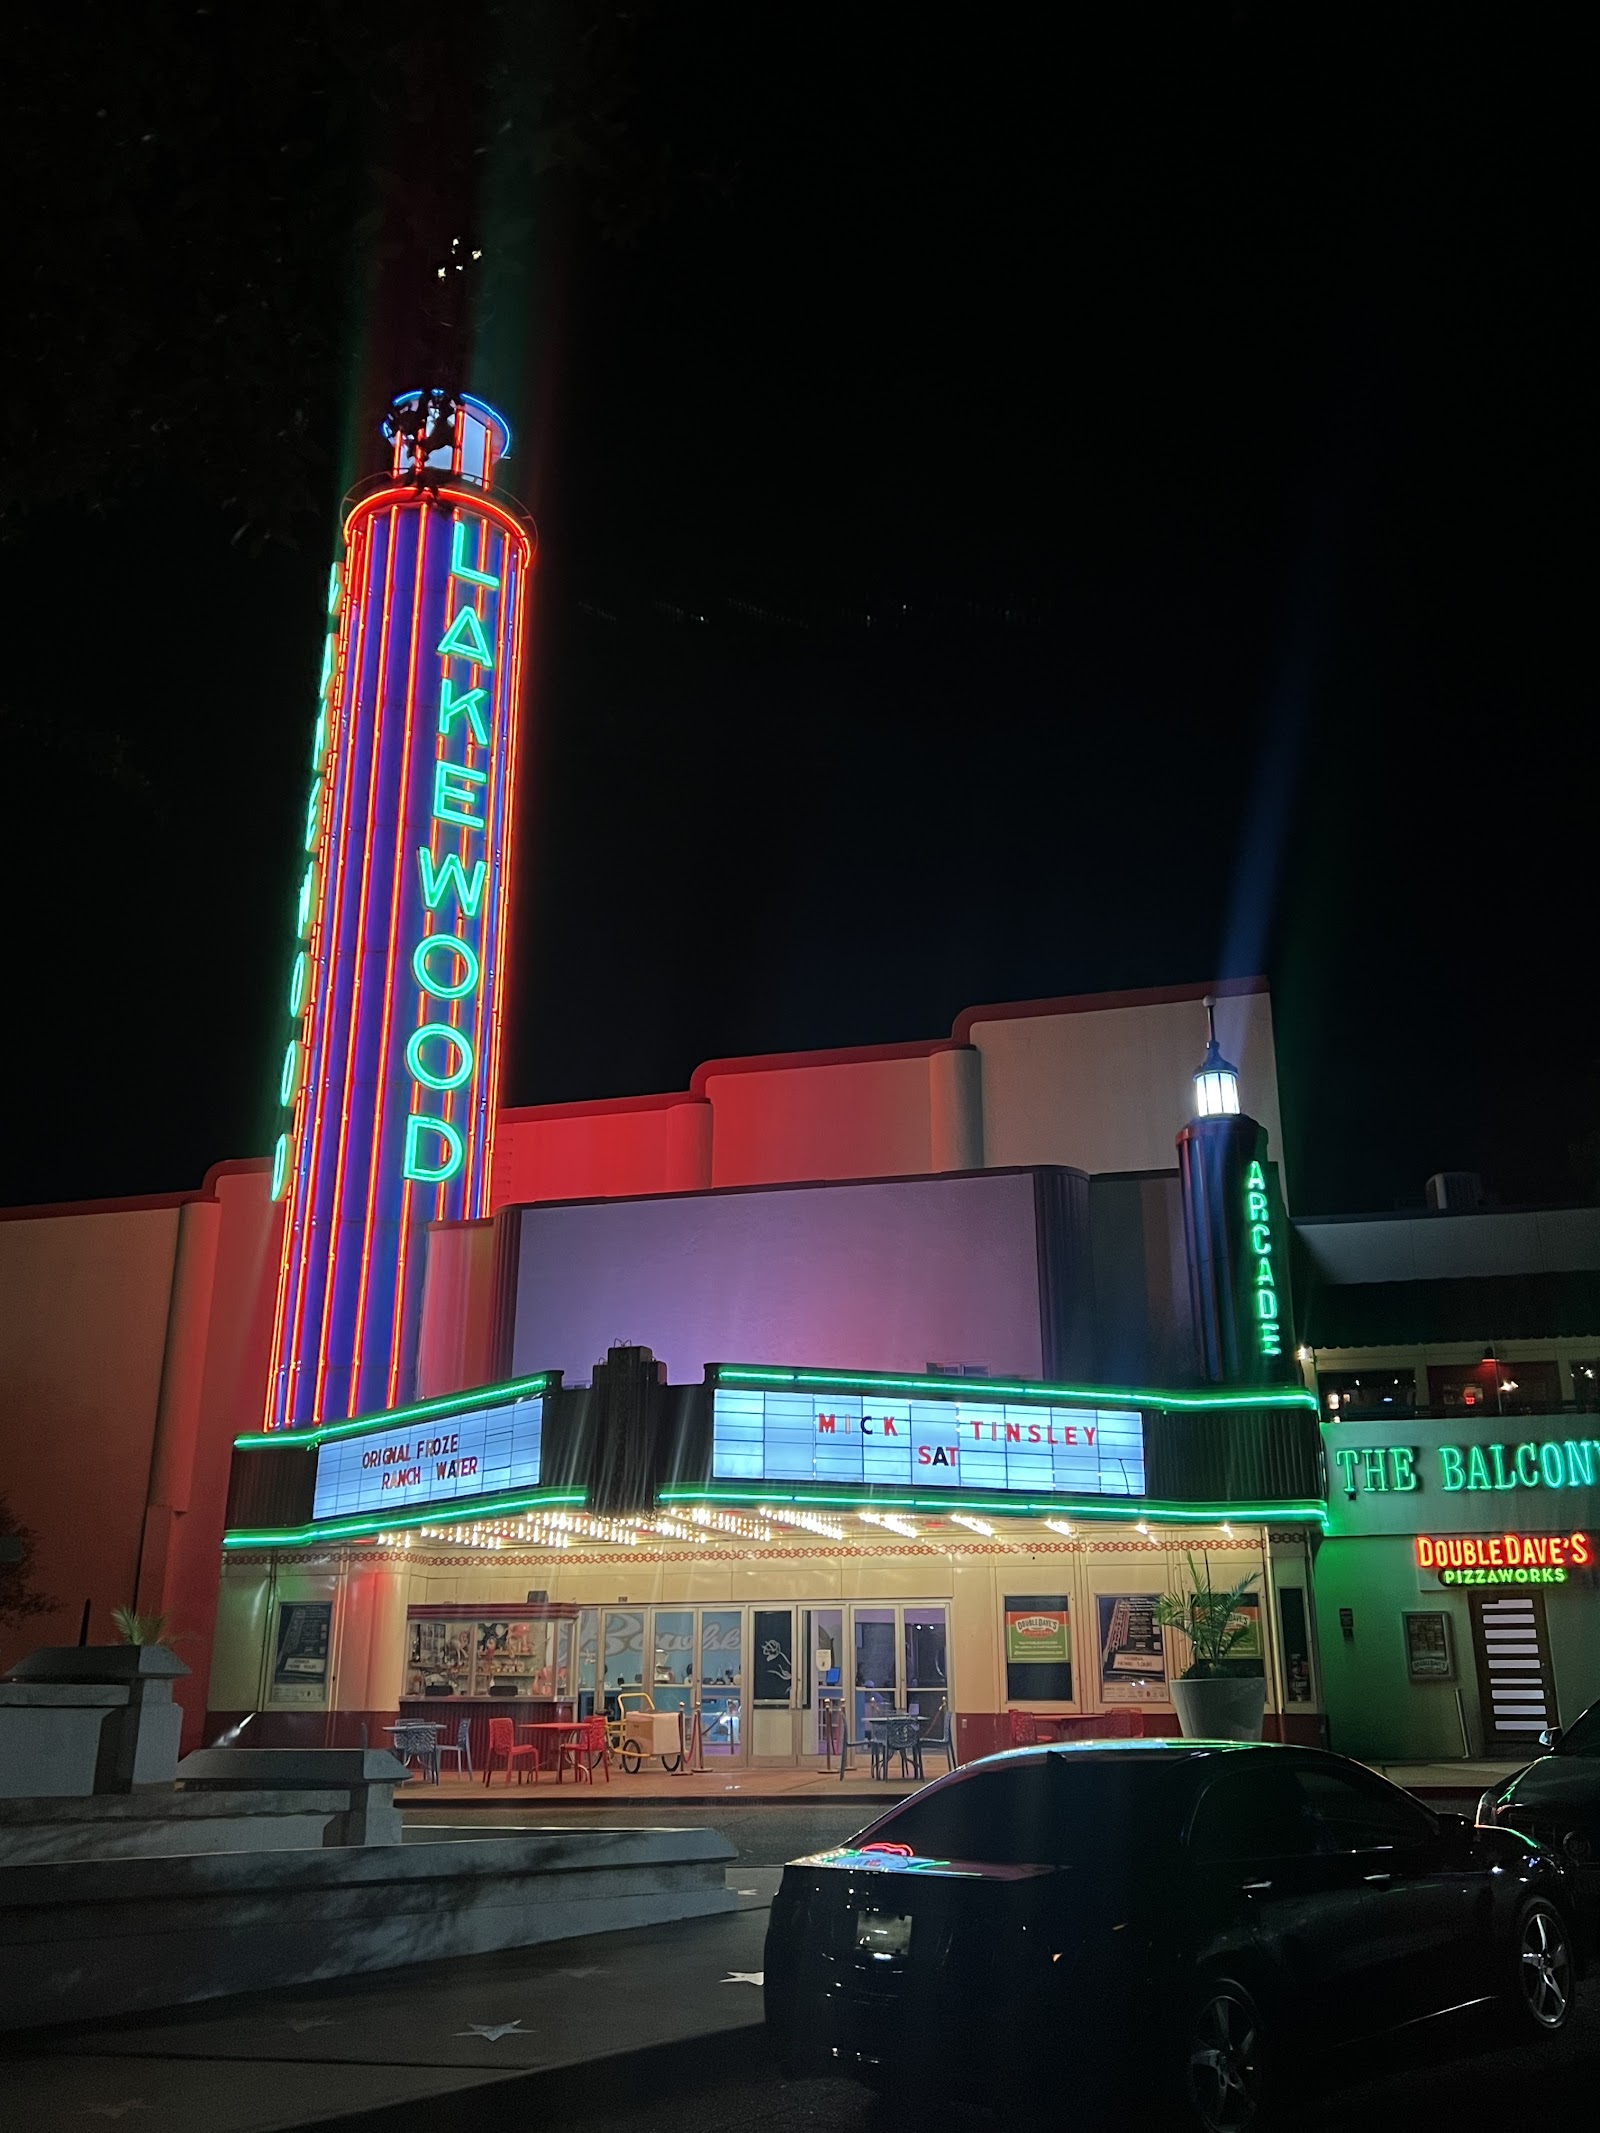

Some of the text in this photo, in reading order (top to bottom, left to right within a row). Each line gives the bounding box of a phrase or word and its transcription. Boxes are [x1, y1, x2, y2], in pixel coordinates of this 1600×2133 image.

[402, 520, 500, 1183] LAKEWOOD
[1247, 1160, 1281, 1357] ARCADE
[416, 1433, 459, 1459] FROZE
[818, 1412, 1096, 1447] MICK TINSLEY
[382, 1455, 478, 1490] RANCH WATER
[918, 1445, 959, 1467] SAT
[1336, 1440, 1600, 1492] THE BALCON
[1444, 1567, 1567, 1584] PIZZAWORKS
